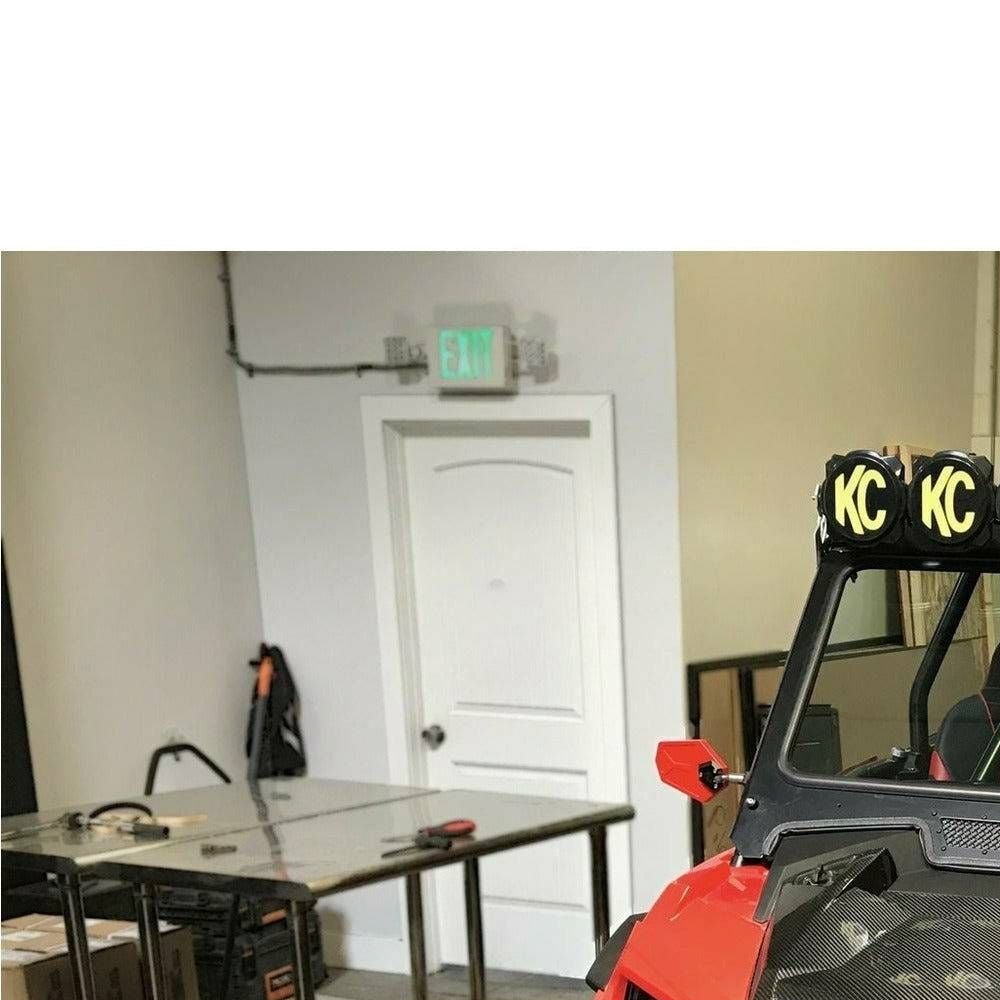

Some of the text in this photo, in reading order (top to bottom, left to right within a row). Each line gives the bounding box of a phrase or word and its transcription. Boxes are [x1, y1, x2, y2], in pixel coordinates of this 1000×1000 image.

[439, 327, 494, 380] EXIT
[834, 465, 887, 535] KC
[922, 466, 976, 538] KC
